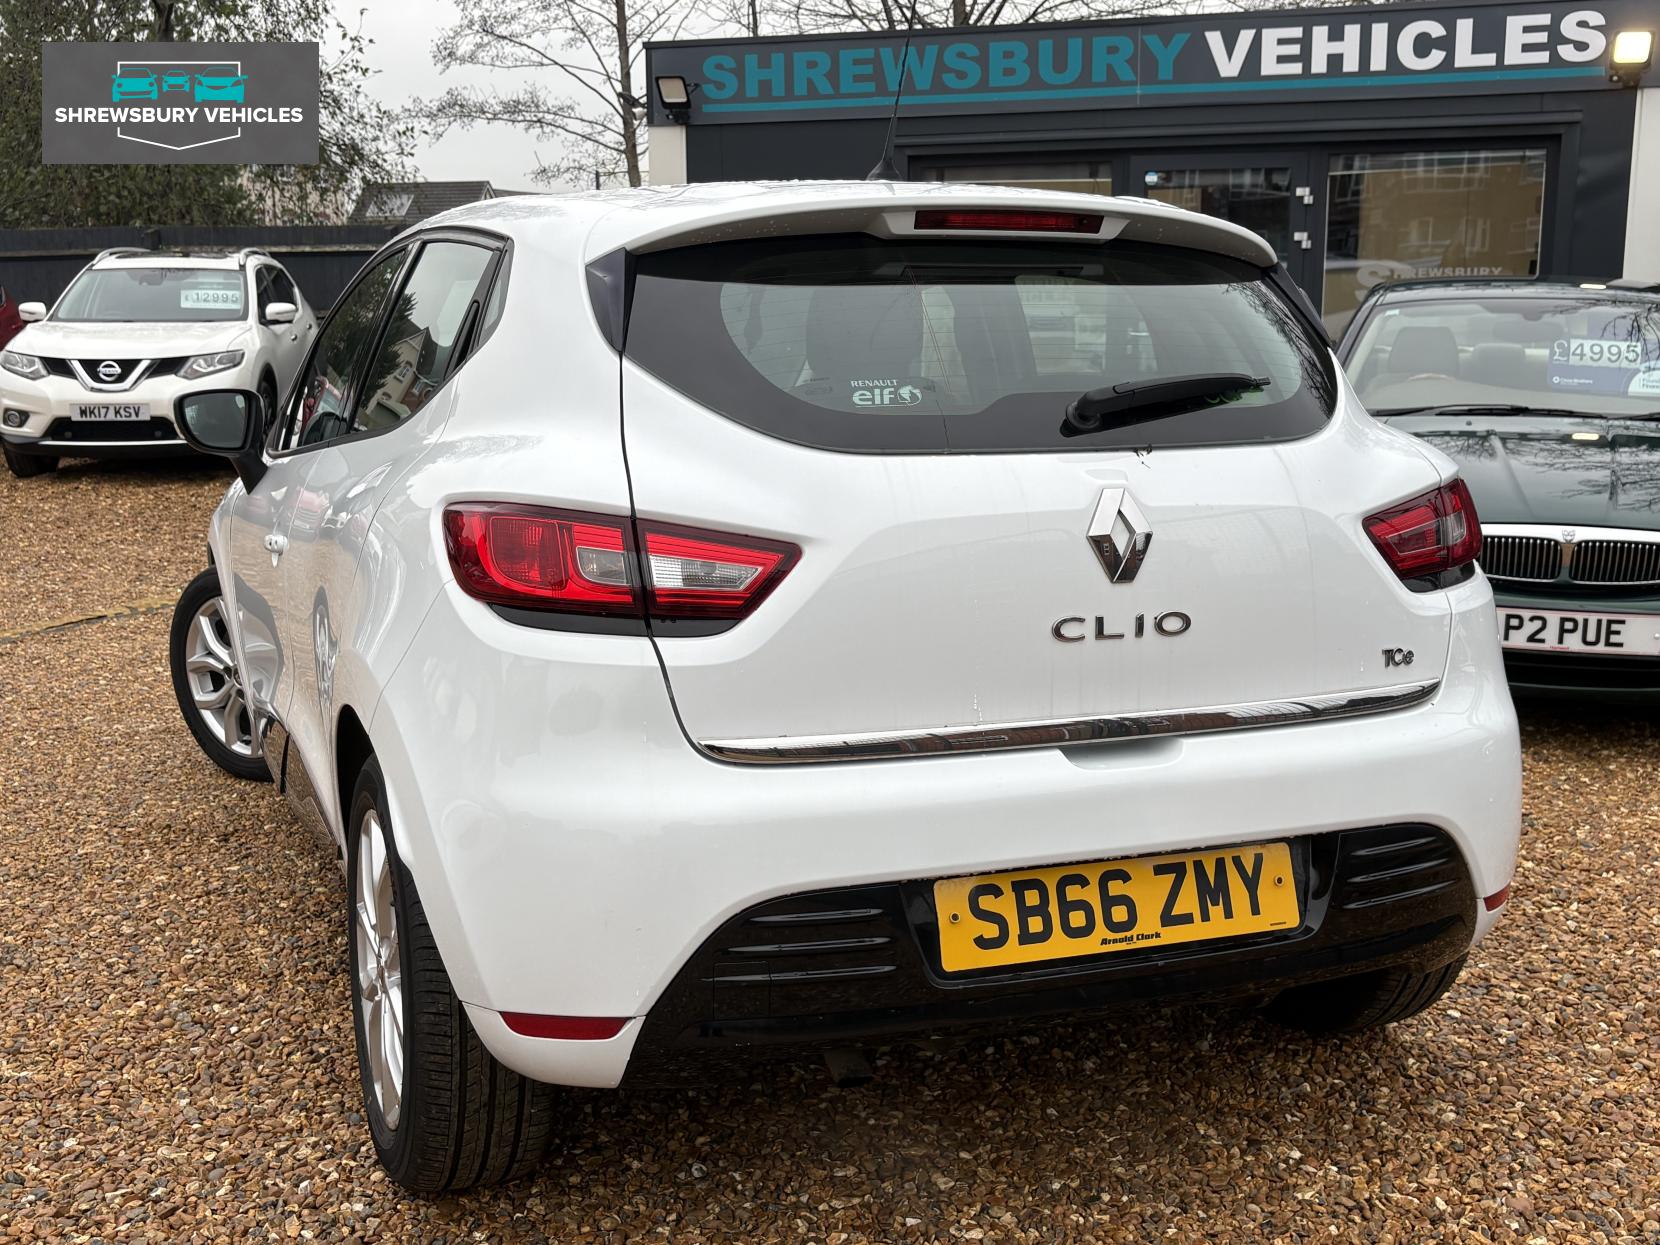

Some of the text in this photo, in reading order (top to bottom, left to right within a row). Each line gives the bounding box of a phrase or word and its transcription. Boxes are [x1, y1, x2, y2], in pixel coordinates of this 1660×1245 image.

[701, 10, 1607, 99] SHREWSBURY VEHICLES
[1553, 340, 1640, 363] £4995
[850, 379, 898, 388] RENAULT
[852, 387, 895, 405] elf
[79, 406, 141, 419] WK17 KSV
[1051, 610, 1192, 643] CLIO
[1503, 613, 1626, 648] P2 PUE
[1381, 647, 1415, 668] TCe
[967, 852, 1264, 951] SB66 ZMY
[1100, 934, 1134, 946] Arnold
[1136, 931, 1162, 941] Clark
